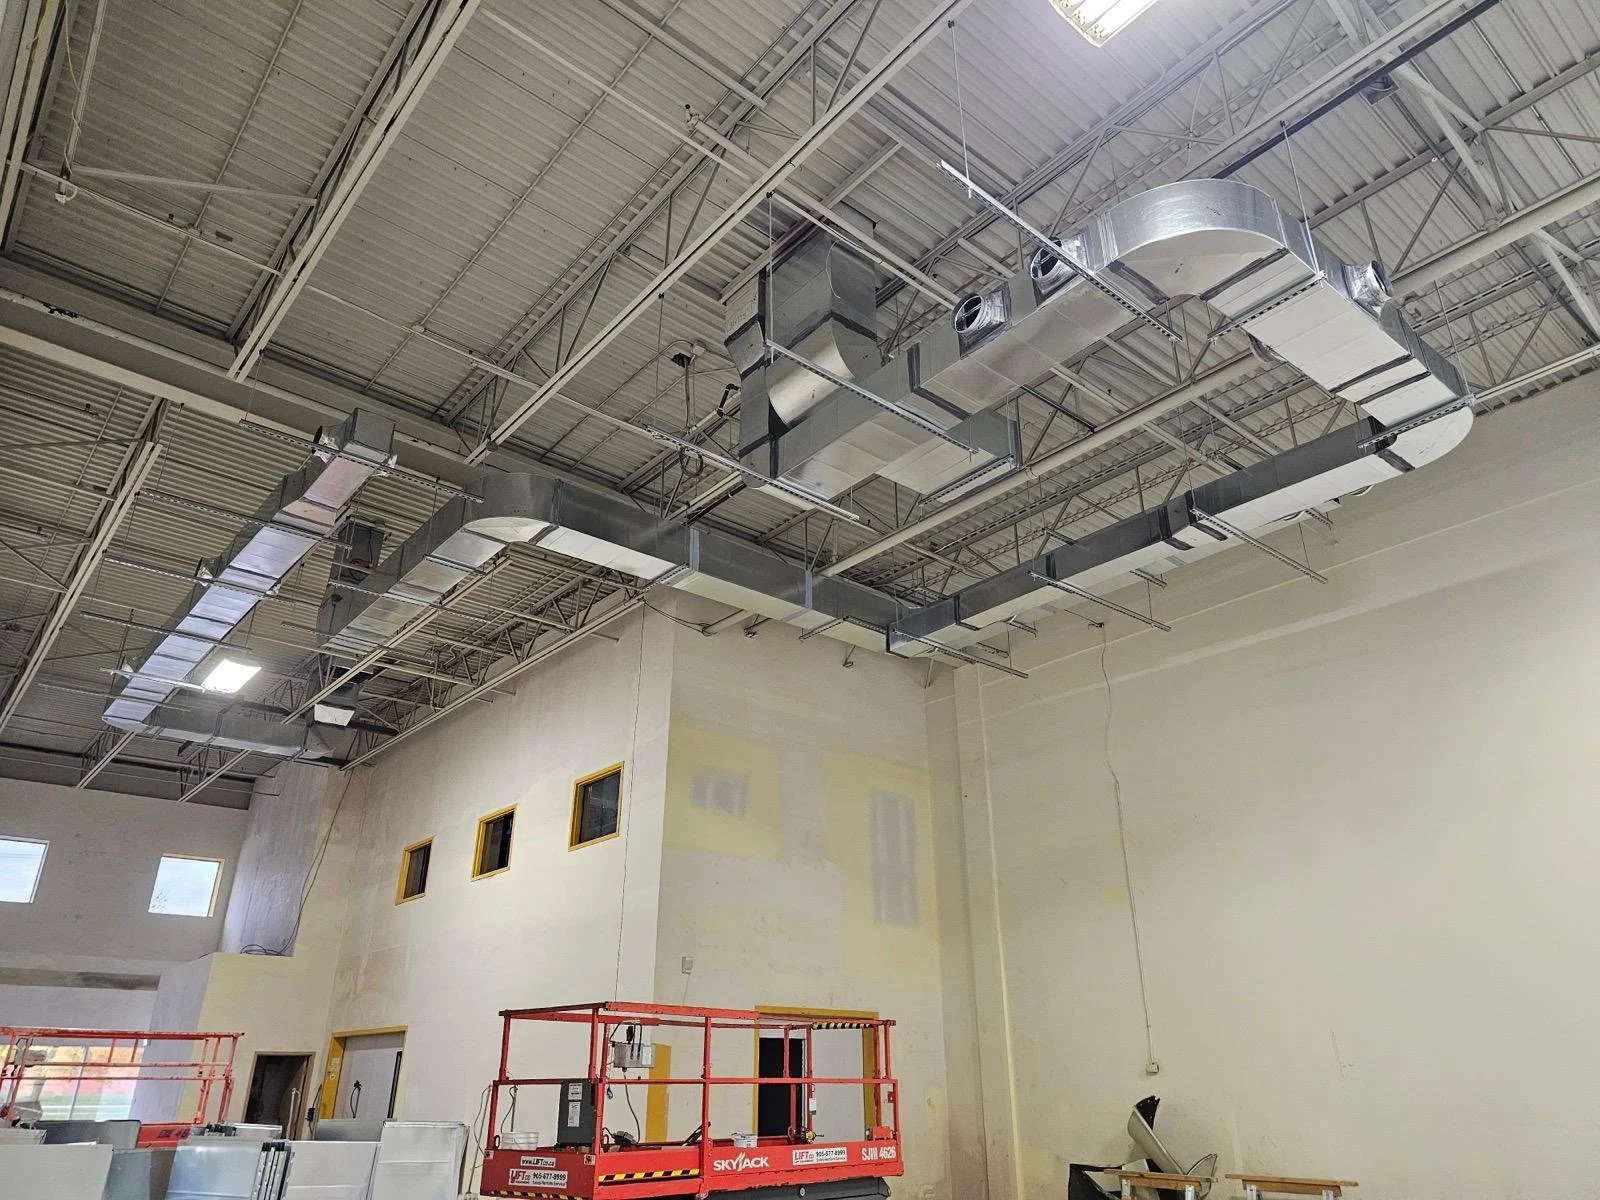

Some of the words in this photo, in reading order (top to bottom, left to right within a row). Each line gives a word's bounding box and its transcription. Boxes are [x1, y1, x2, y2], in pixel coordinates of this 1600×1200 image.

[879, 1145, 897, 1159] 4626
[713, 1151, 770, 1171] SKYJACK
[532, 1172, 566, 1181] 905-677-8999
